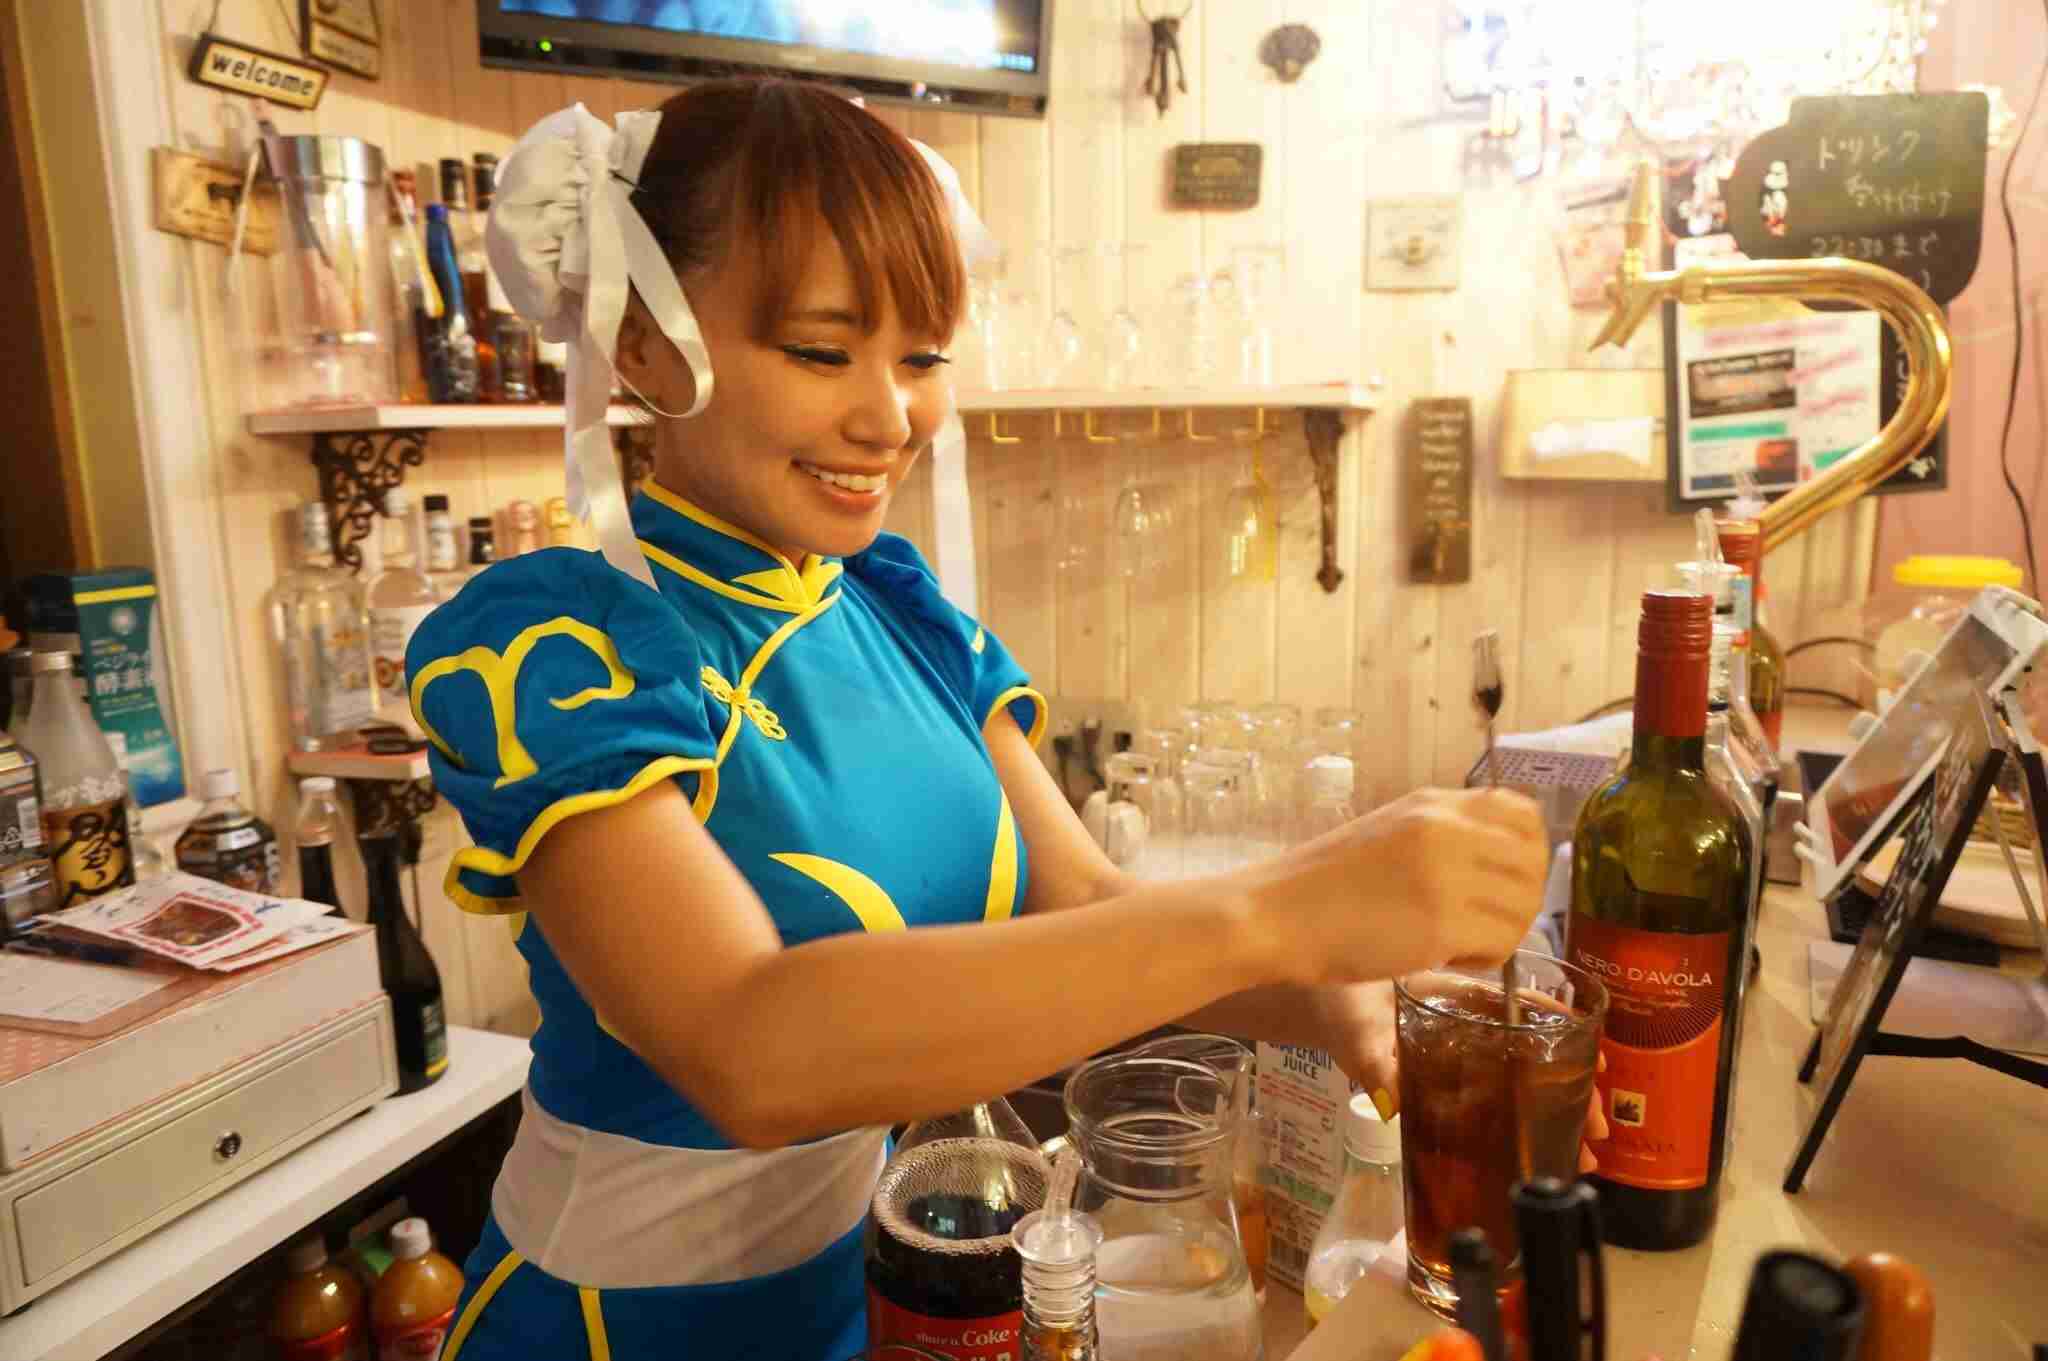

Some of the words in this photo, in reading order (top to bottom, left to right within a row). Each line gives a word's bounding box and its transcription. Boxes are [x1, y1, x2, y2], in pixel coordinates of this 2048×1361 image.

[211, 53, 314, 96] welcome
[1576, 948, 1622, 977] NERO
[1626, 967, 1713, 987] D'AVOLA
[1283, 1055, 1319, 1081] JUICE
[961, 1328, 1010, 1347] Coke
